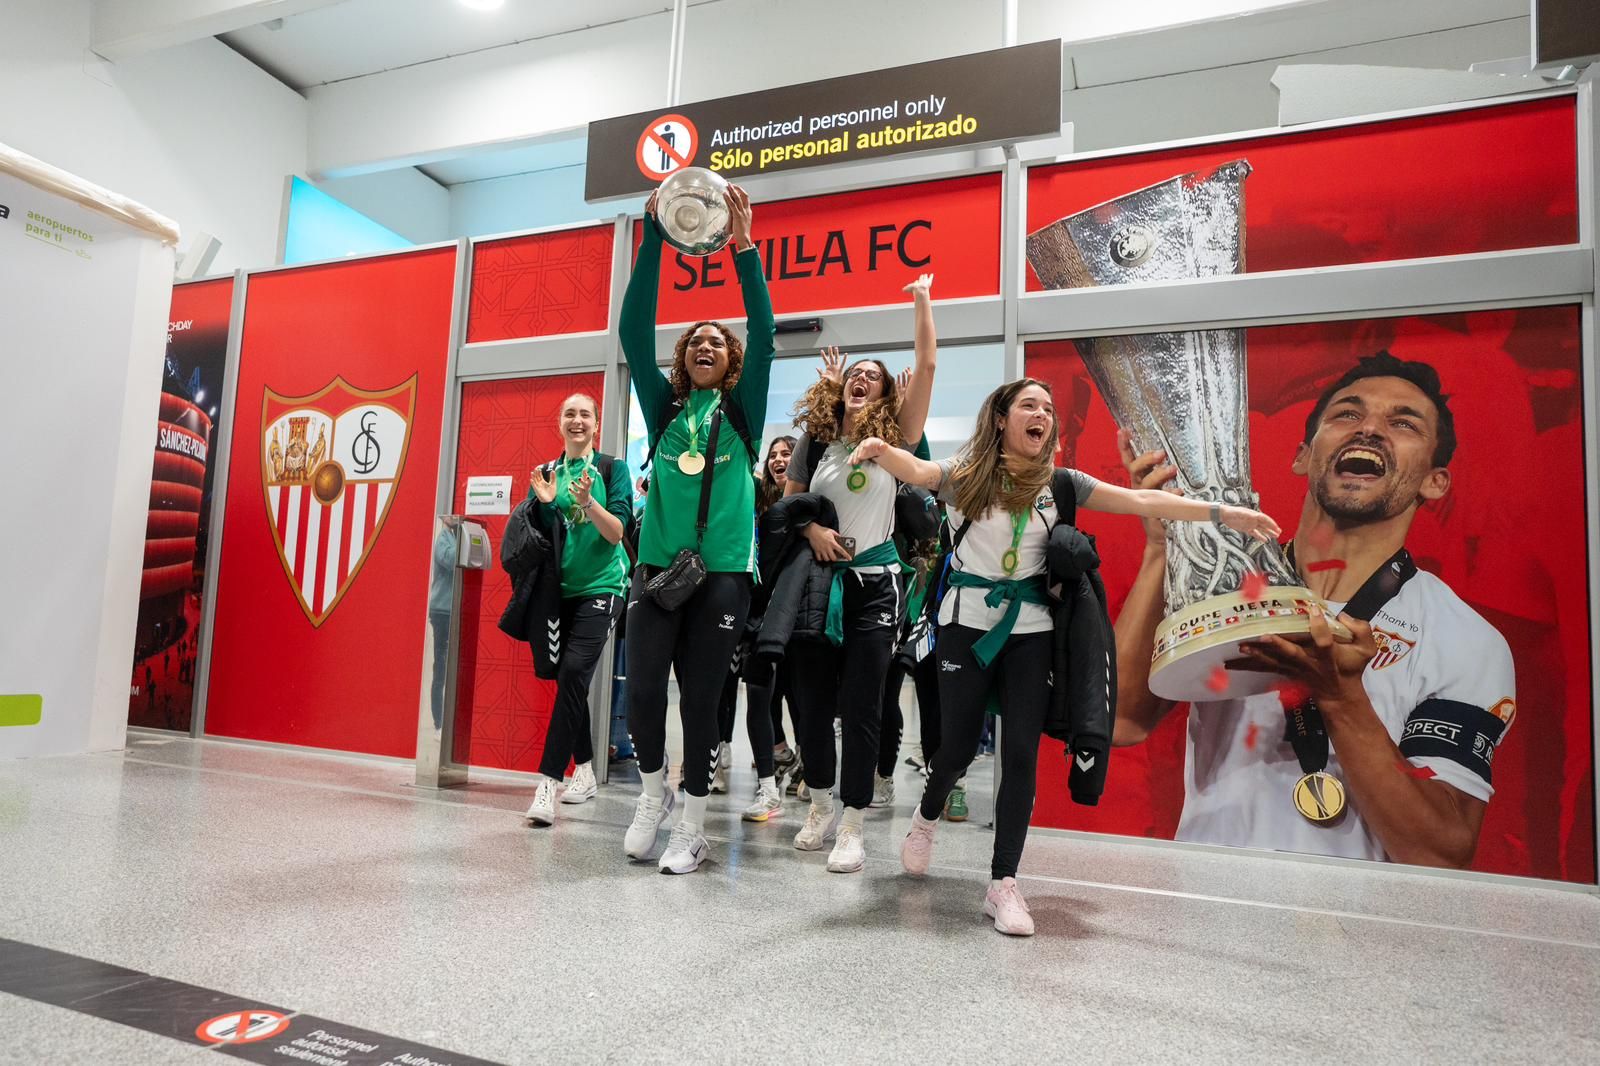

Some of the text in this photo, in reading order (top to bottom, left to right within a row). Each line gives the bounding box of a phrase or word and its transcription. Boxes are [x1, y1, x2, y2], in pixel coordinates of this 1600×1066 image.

[710, 95, 947, 147] Authorized personnel only
[709, 113, 978, 172] Sólo personal autorizado
[25, 222, 63, 243] para ti
[26, 210, 94, 242] aeropuertos
[673, 219, 932, 292] SEVILLA FC
[168, 319, 193, 331] CHDAY
[1232, 599, 1284, 613] UEFA
[1376, 610, 1408, 629] Thank
[1403, 722, 1461, 740] SPECT
[307, 1029, 380, 1053] Personnel
